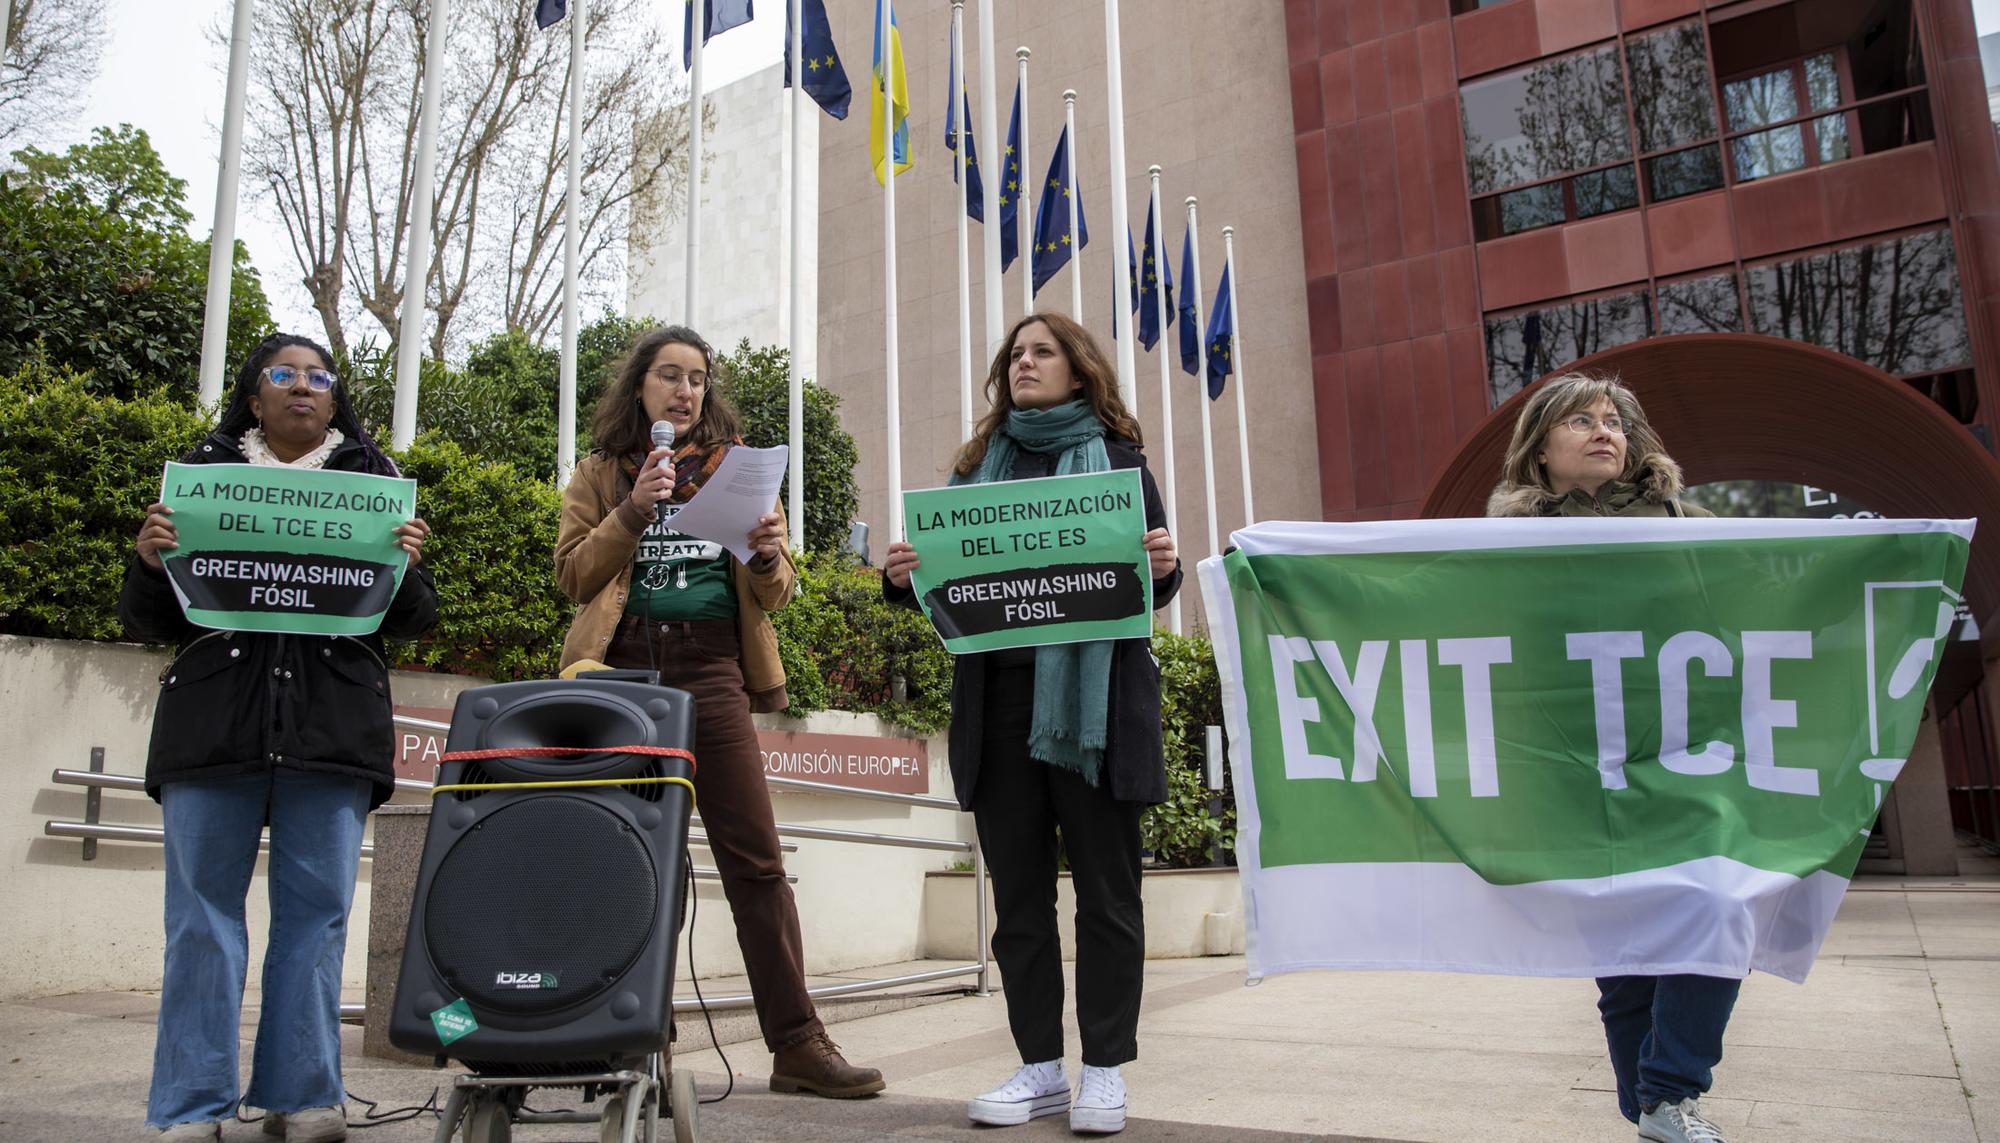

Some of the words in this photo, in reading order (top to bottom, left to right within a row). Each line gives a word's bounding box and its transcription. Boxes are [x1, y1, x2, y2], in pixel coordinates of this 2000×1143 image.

[175, 482, 206, 498] LA
[213, 483, 404, 515] MODERNIZACIÓN
[916, 511, 946, 532] LA
[952, 490, 1131, 528] MODERNIZACIÓN
[218, 512, 265, 533] DEL
[272, 516, 318, 538] TCE
[323, 520, 353, 540] ES
[639, 544, 707, 558] TREATY
[961, 537, 1005, 558] DEL
[1008, 531, 1053, 553] TCE
[1058, 527, 1087, 548] ES
[191, 557, 375, 588] GREENWASHING
[250, 583, 316, 609] FÓSIL
[947, 570, 1117, 605] GREENWASHING
[1004, 600, 1066, 623] FÓSIL
[1266, 633, 1513, 798] EXIT
[1565, 629, 1821, 797] TCE
[402, 734, 448, 761] PA
[760, 749, 843, 775] COMISIÓN
[848, 754, 920, 776] EUROPEA
[496, 971, 542, 985] ibiza
